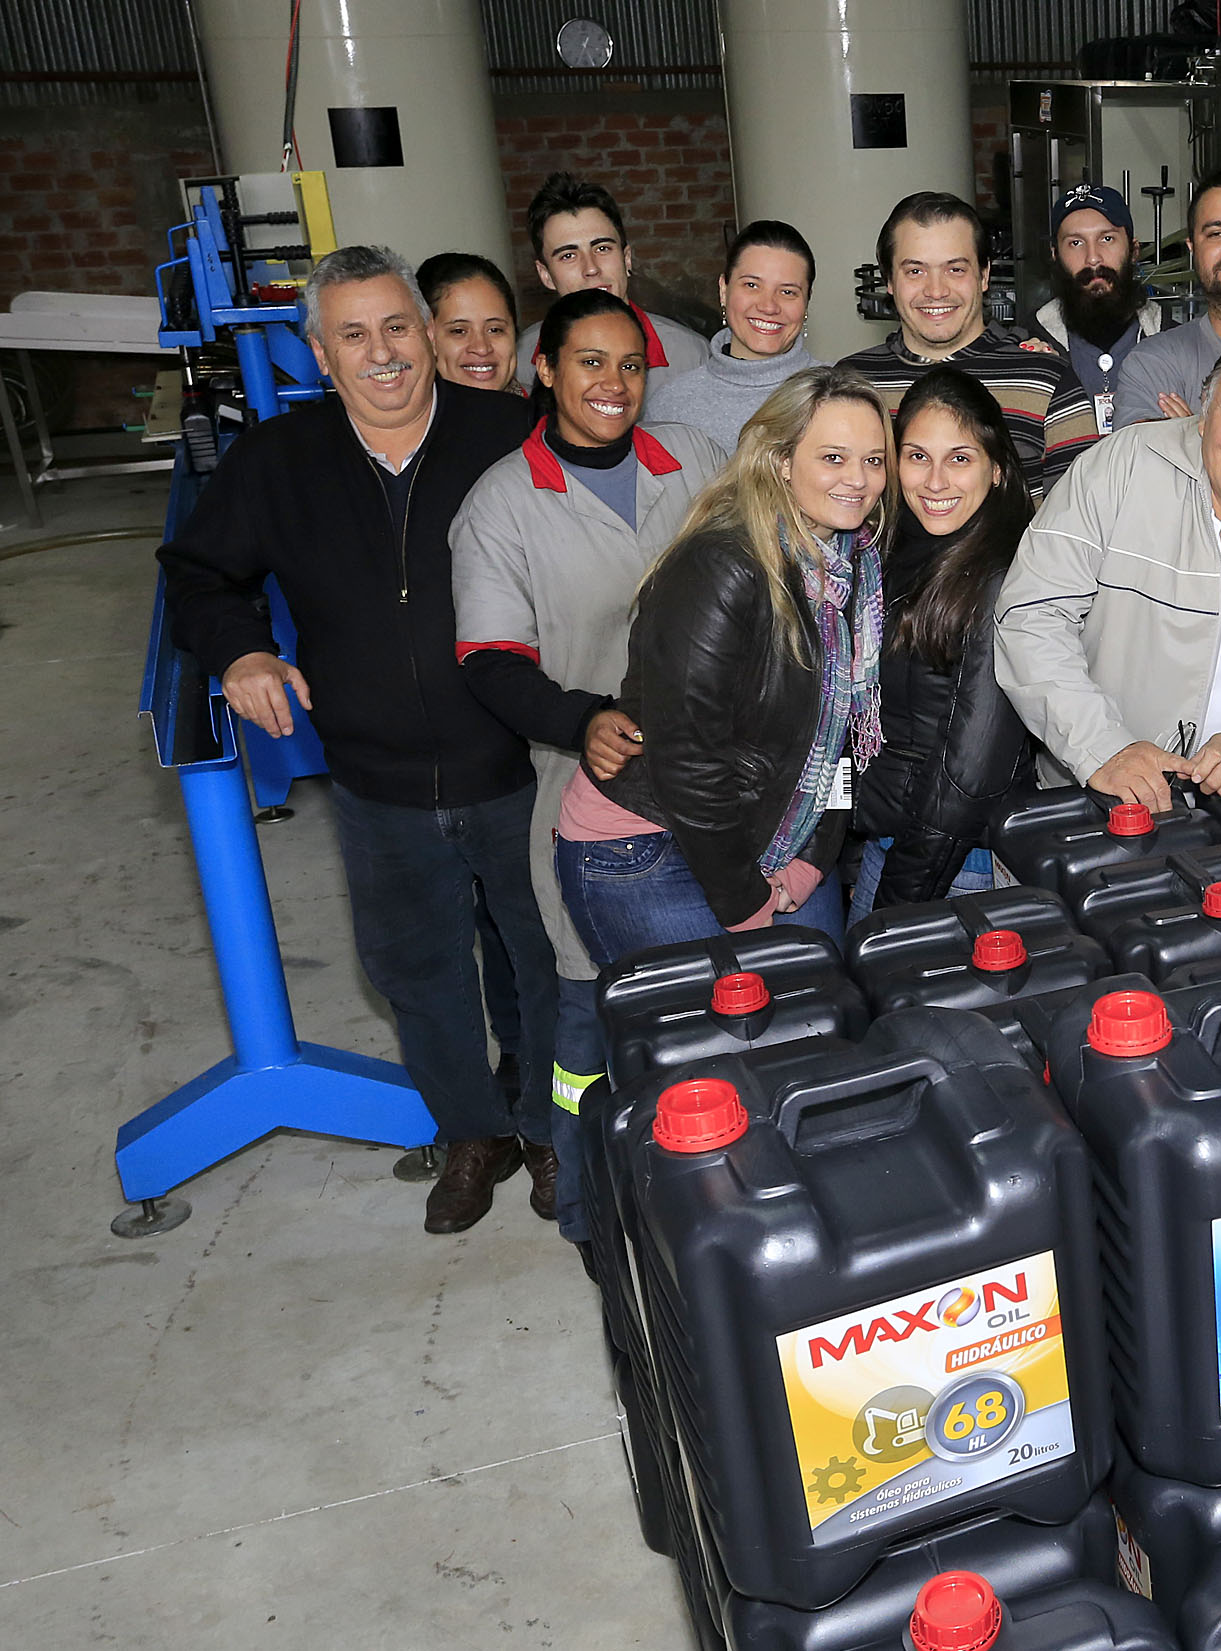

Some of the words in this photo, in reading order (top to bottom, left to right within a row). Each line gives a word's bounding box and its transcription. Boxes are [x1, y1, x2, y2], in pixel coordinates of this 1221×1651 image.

[808, 1272, 1029, 1369] MAXON
[987, 1308, 1030, 1329] OIL
[951, 1324, 1047, 1369] HIDRÁULICO
[943, 1391, 1008, 1440] 68
[968, 1435, 988, 1451] HL
[849, 1499, 899, 1523] Sistemas
[902, 1477, 962, 1504] Hidráulicos
[876, 1488, 901, 1501] Óleo
[904, 1477, 930, 1494] para
